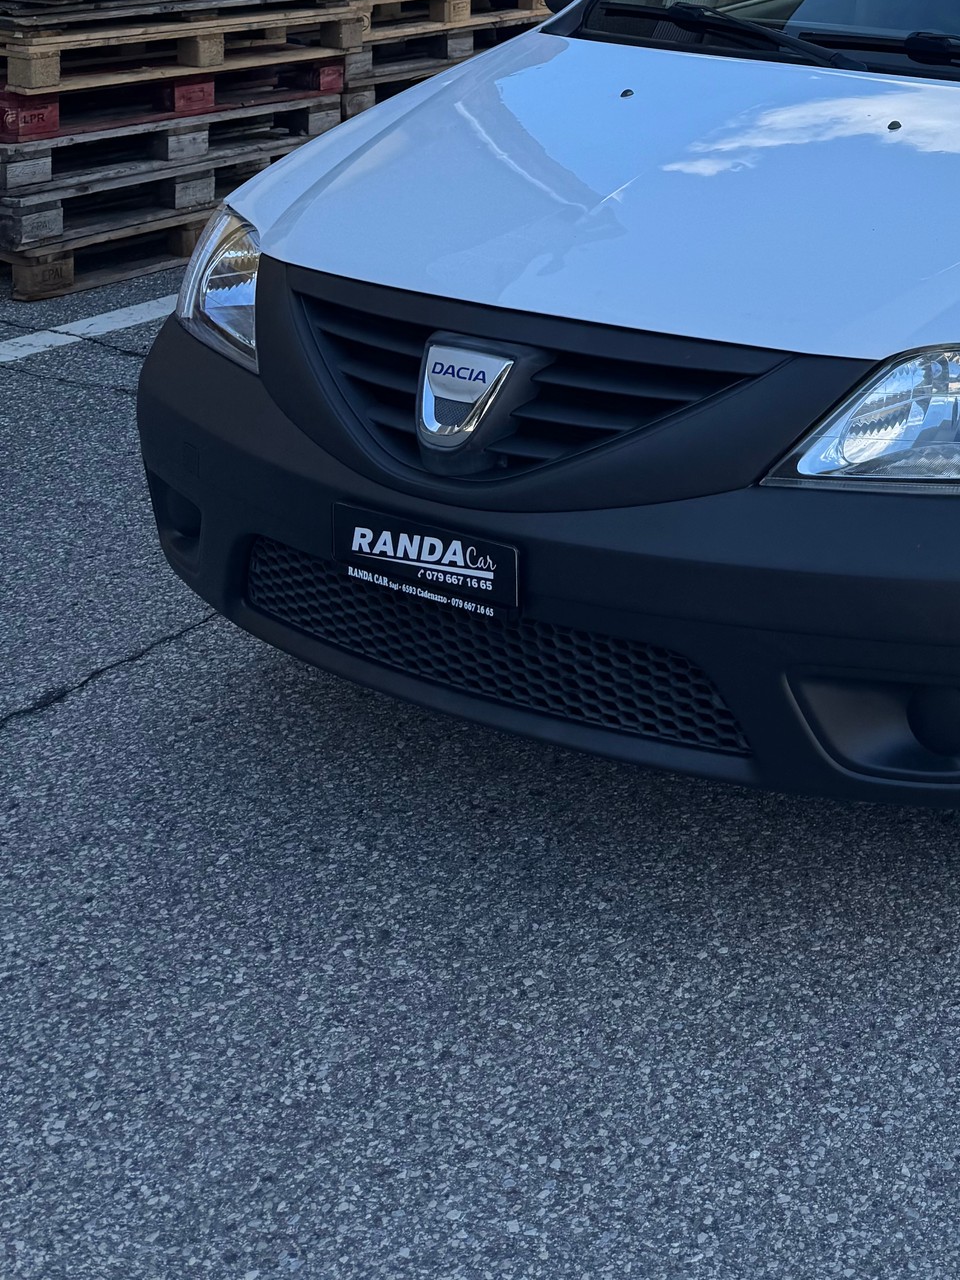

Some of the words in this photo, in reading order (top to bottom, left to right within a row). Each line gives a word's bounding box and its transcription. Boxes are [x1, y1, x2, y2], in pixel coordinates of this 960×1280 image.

[23, 113, 46, 124] LPR
[431, 361, 487, 384] DACIA
[351, 526, 465, 567] RANDA
[465, 546, 497, 571] Car
[347, 566, 373, 583] RANDA
[373, 574, 389, 587] CAR
[402, 583, 417, 595] 6593
[417, 588, 448, 604] Cadenazzo
[451, 597, 463, 608] 079
[463, 601, 476, 613] 667
[476, 604, 485, 615] 16
[485, 606, 494, 617] 65
[425, 570, 444, 582] 079
[445, 574, 464, 586] 667
[466, 578, 478, 588] 16
[479, 580, 493, 591] 65
